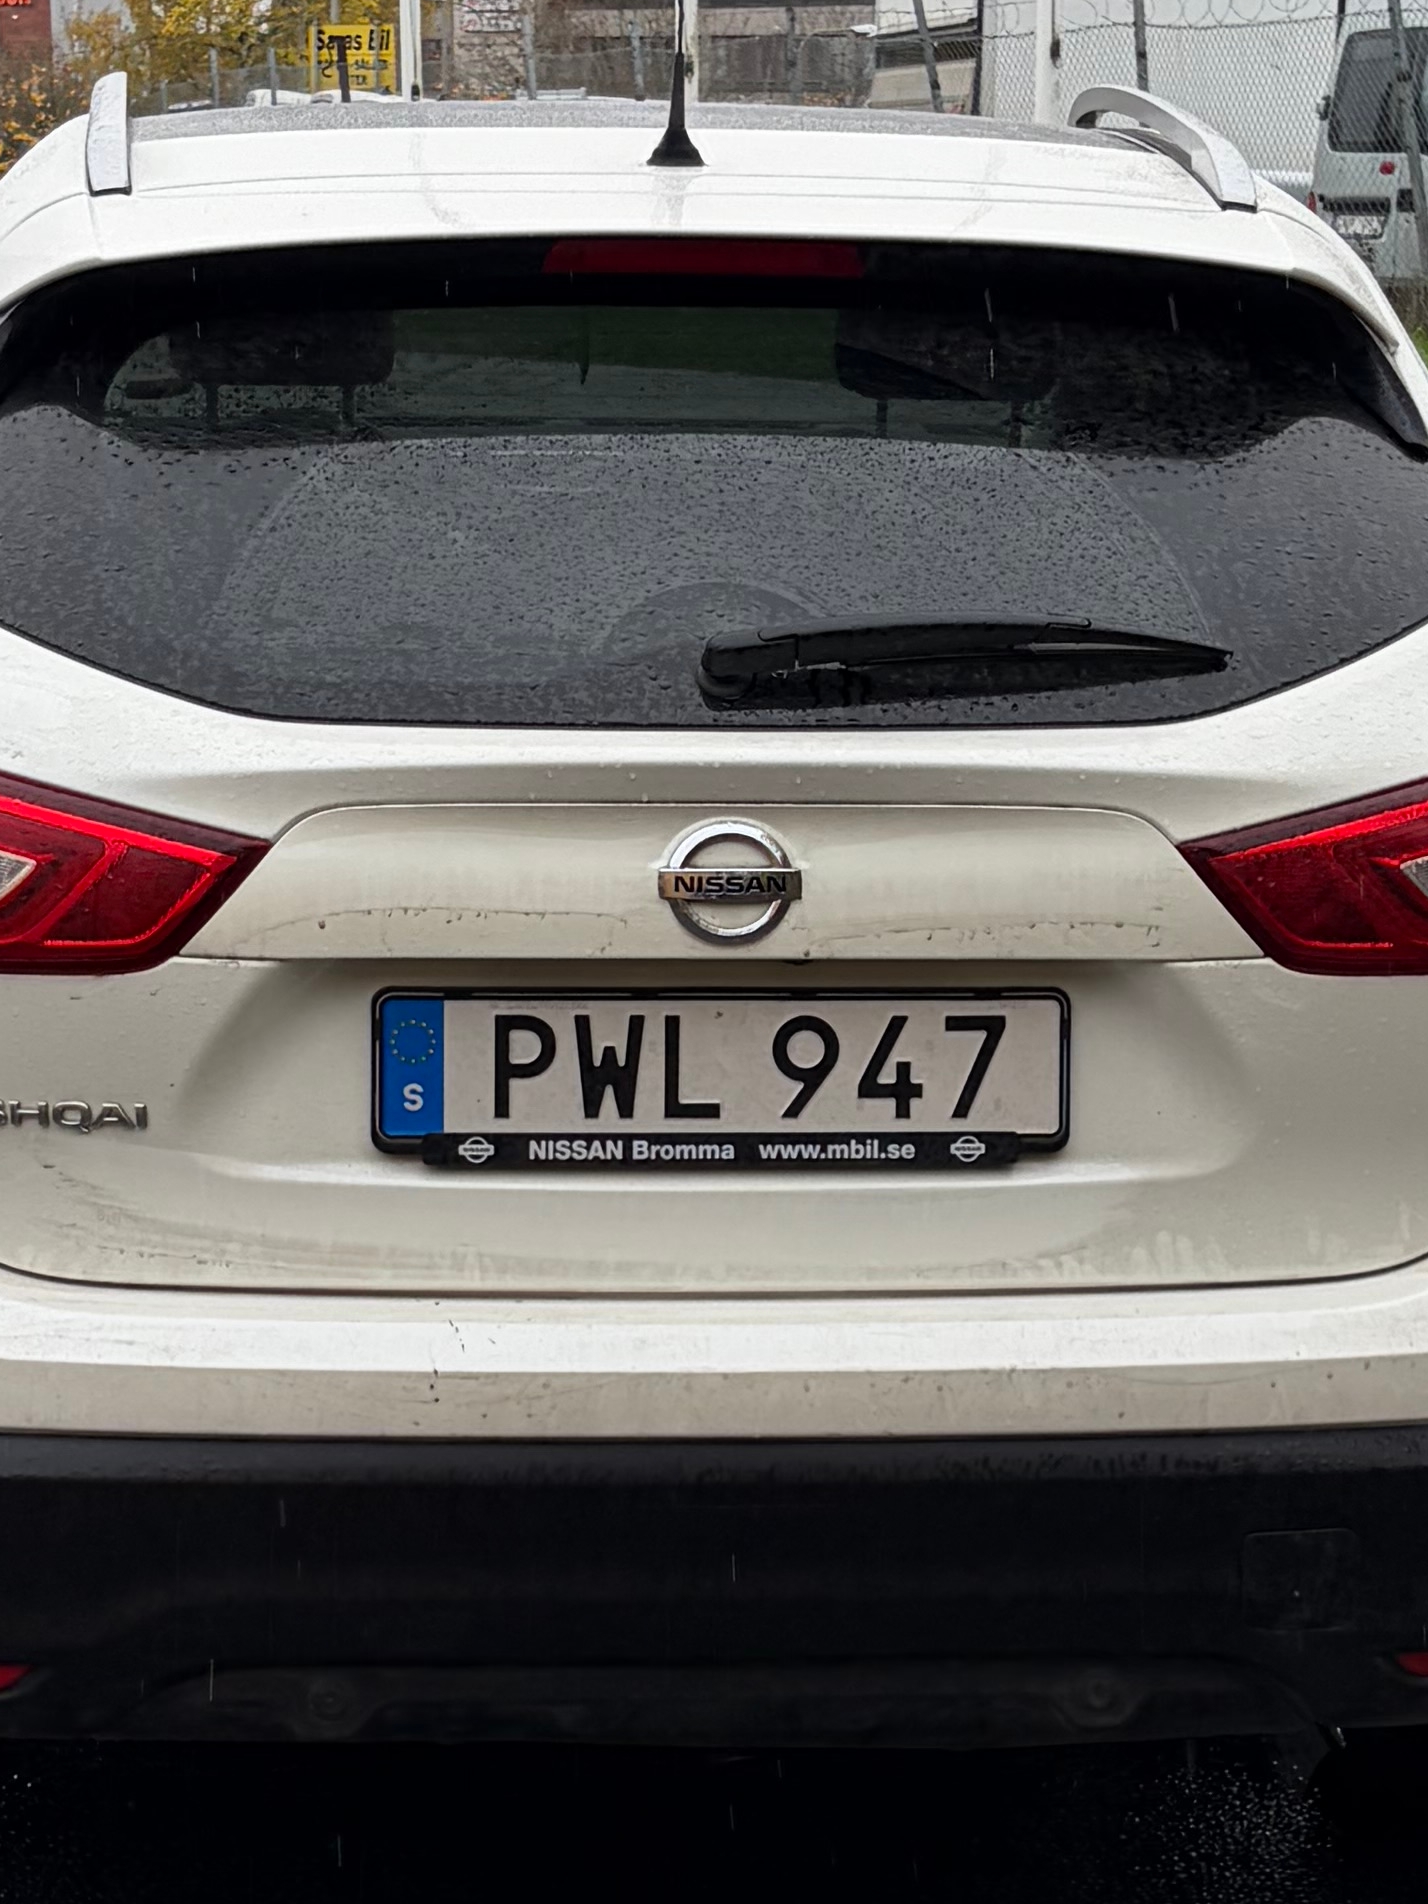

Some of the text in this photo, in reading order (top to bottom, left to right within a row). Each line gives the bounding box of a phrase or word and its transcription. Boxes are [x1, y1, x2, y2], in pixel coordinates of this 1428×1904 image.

[674, 876, 787, 893] NISSAN
[494, 1015, 1008, 1120] PWL 947
[403, 1083, 424, 1112] S
[528, 1140, 735, 1161] NISSAN Bromma
[759, 1140, 916, 1160] www.mbil.se
